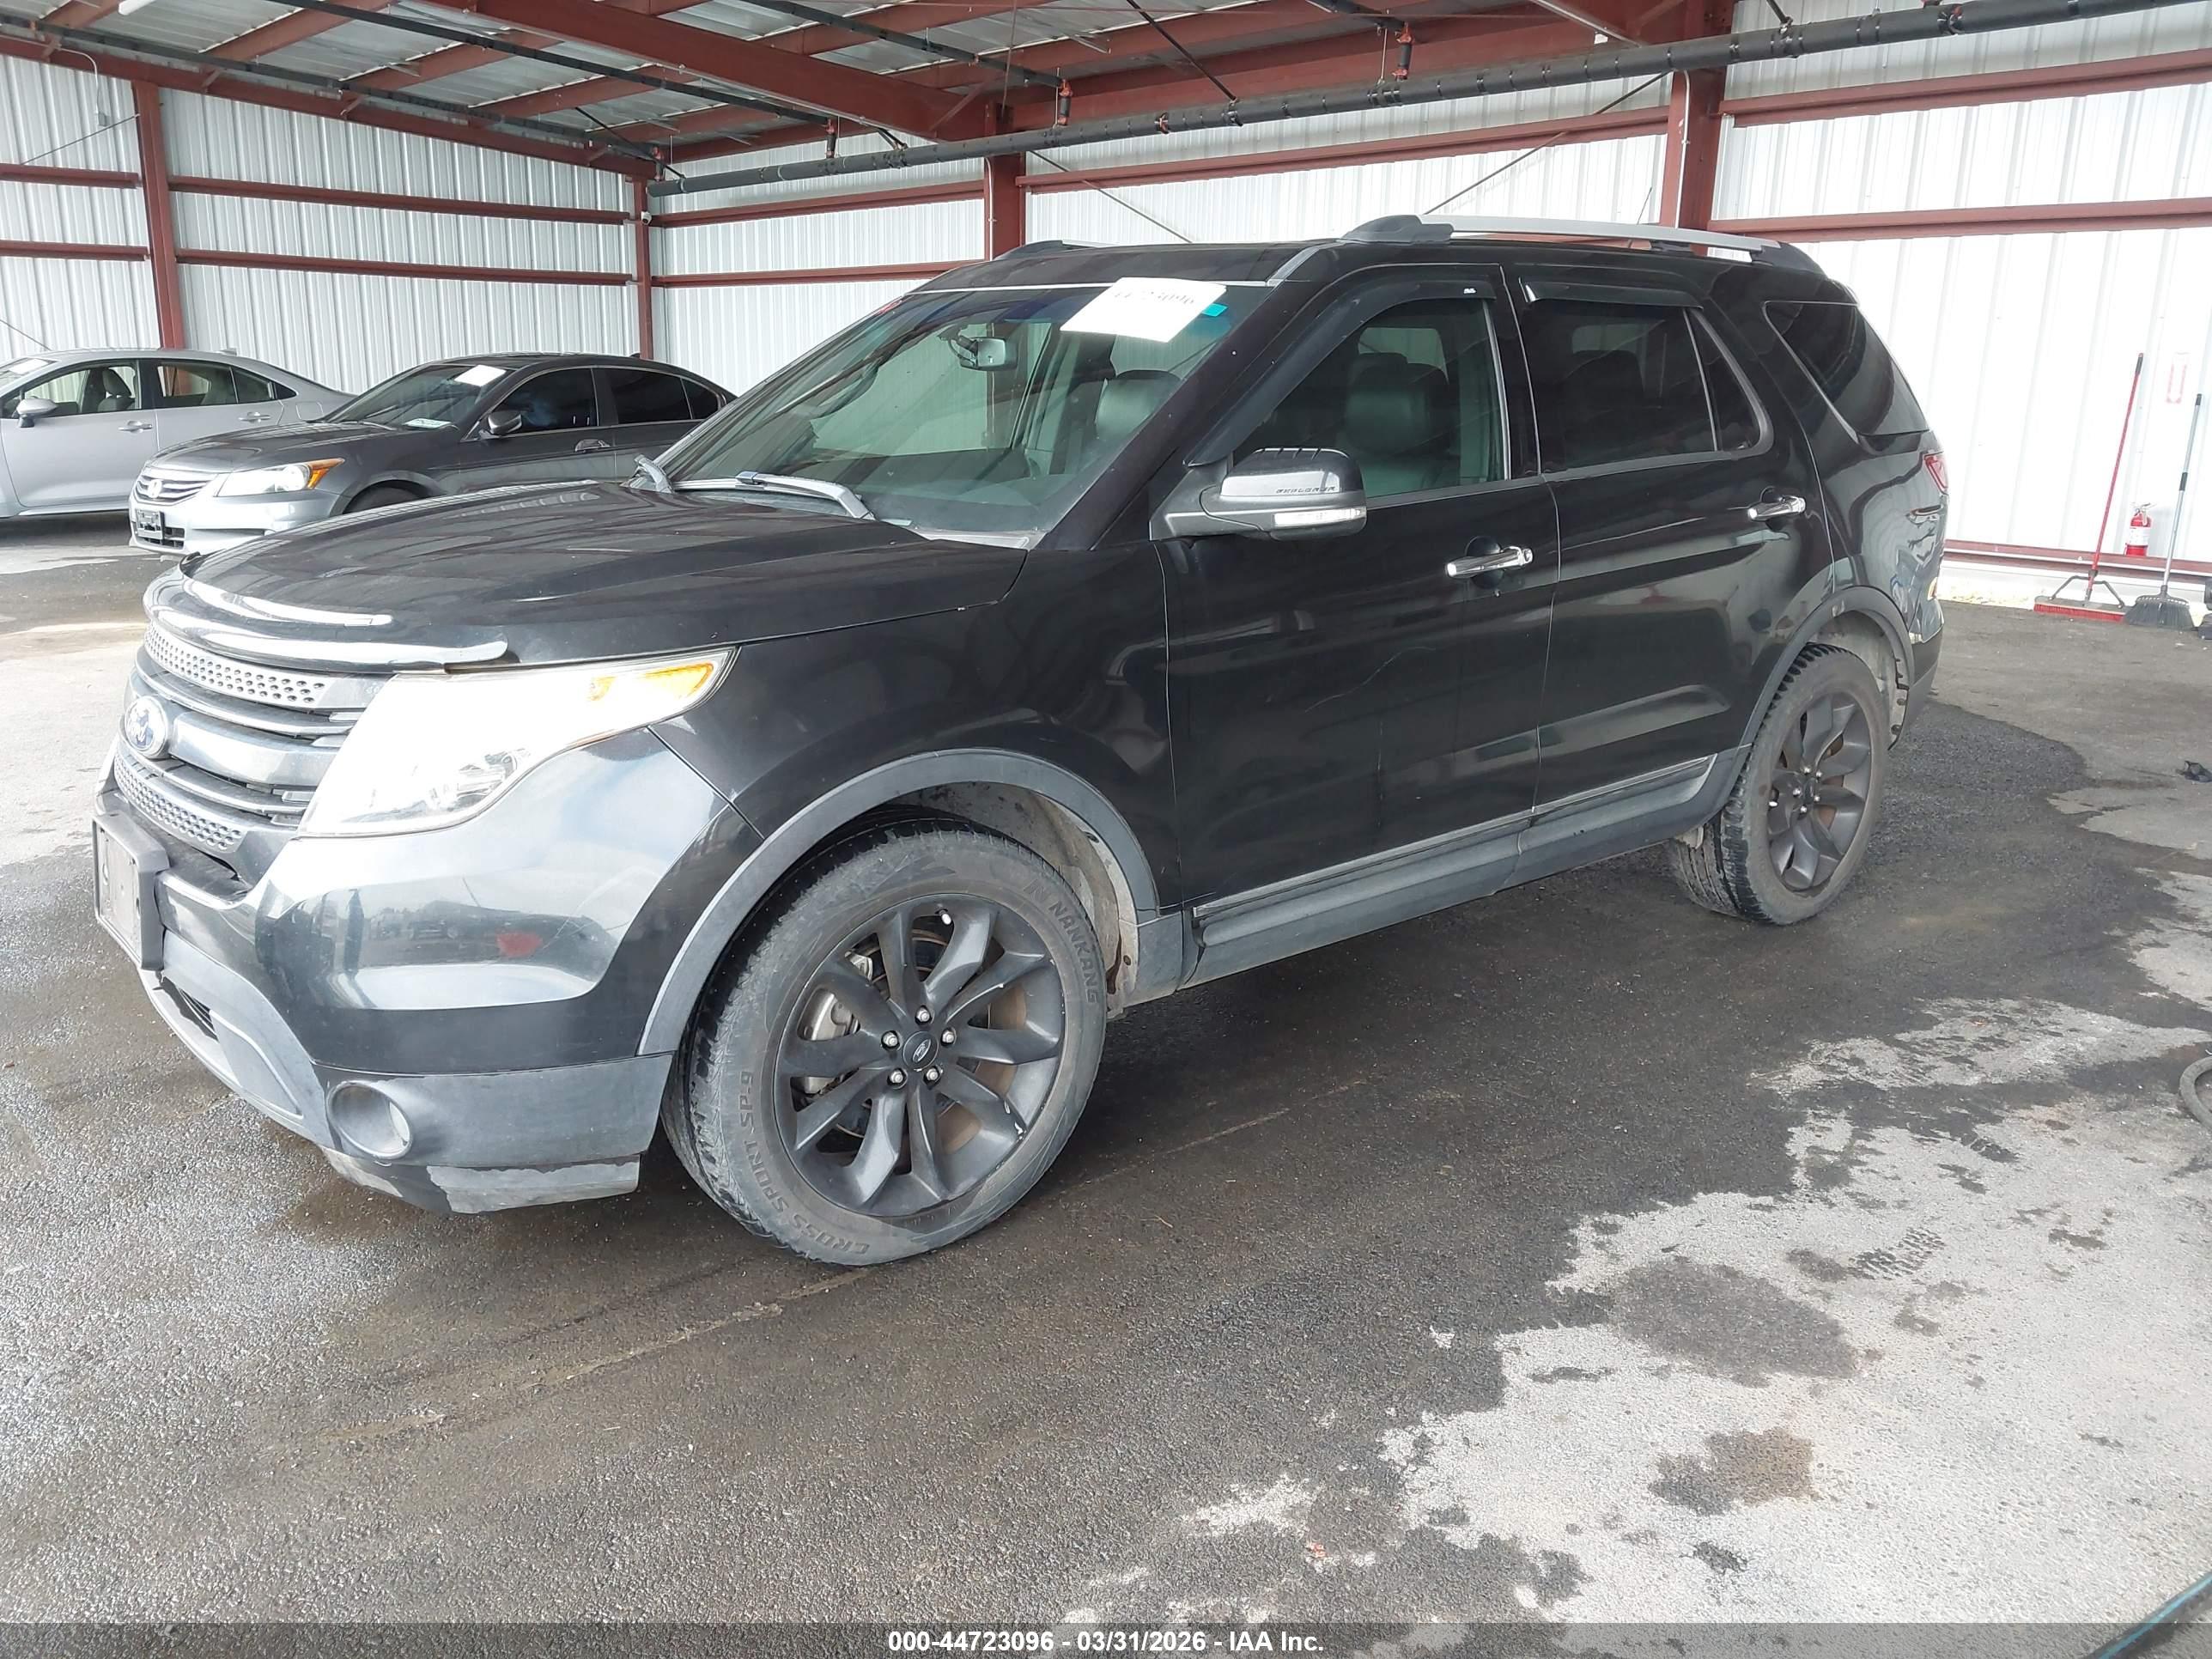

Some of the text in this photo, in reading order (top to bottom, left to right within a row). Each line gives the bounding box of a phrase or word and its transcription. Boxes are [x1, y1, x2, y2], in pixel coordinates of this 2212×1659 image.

[1048, 900, 1098, 1003] NANKANG
[744, 1140, 790, 1212] SPORT
[788, 1213, 871, 1255] CROSS
